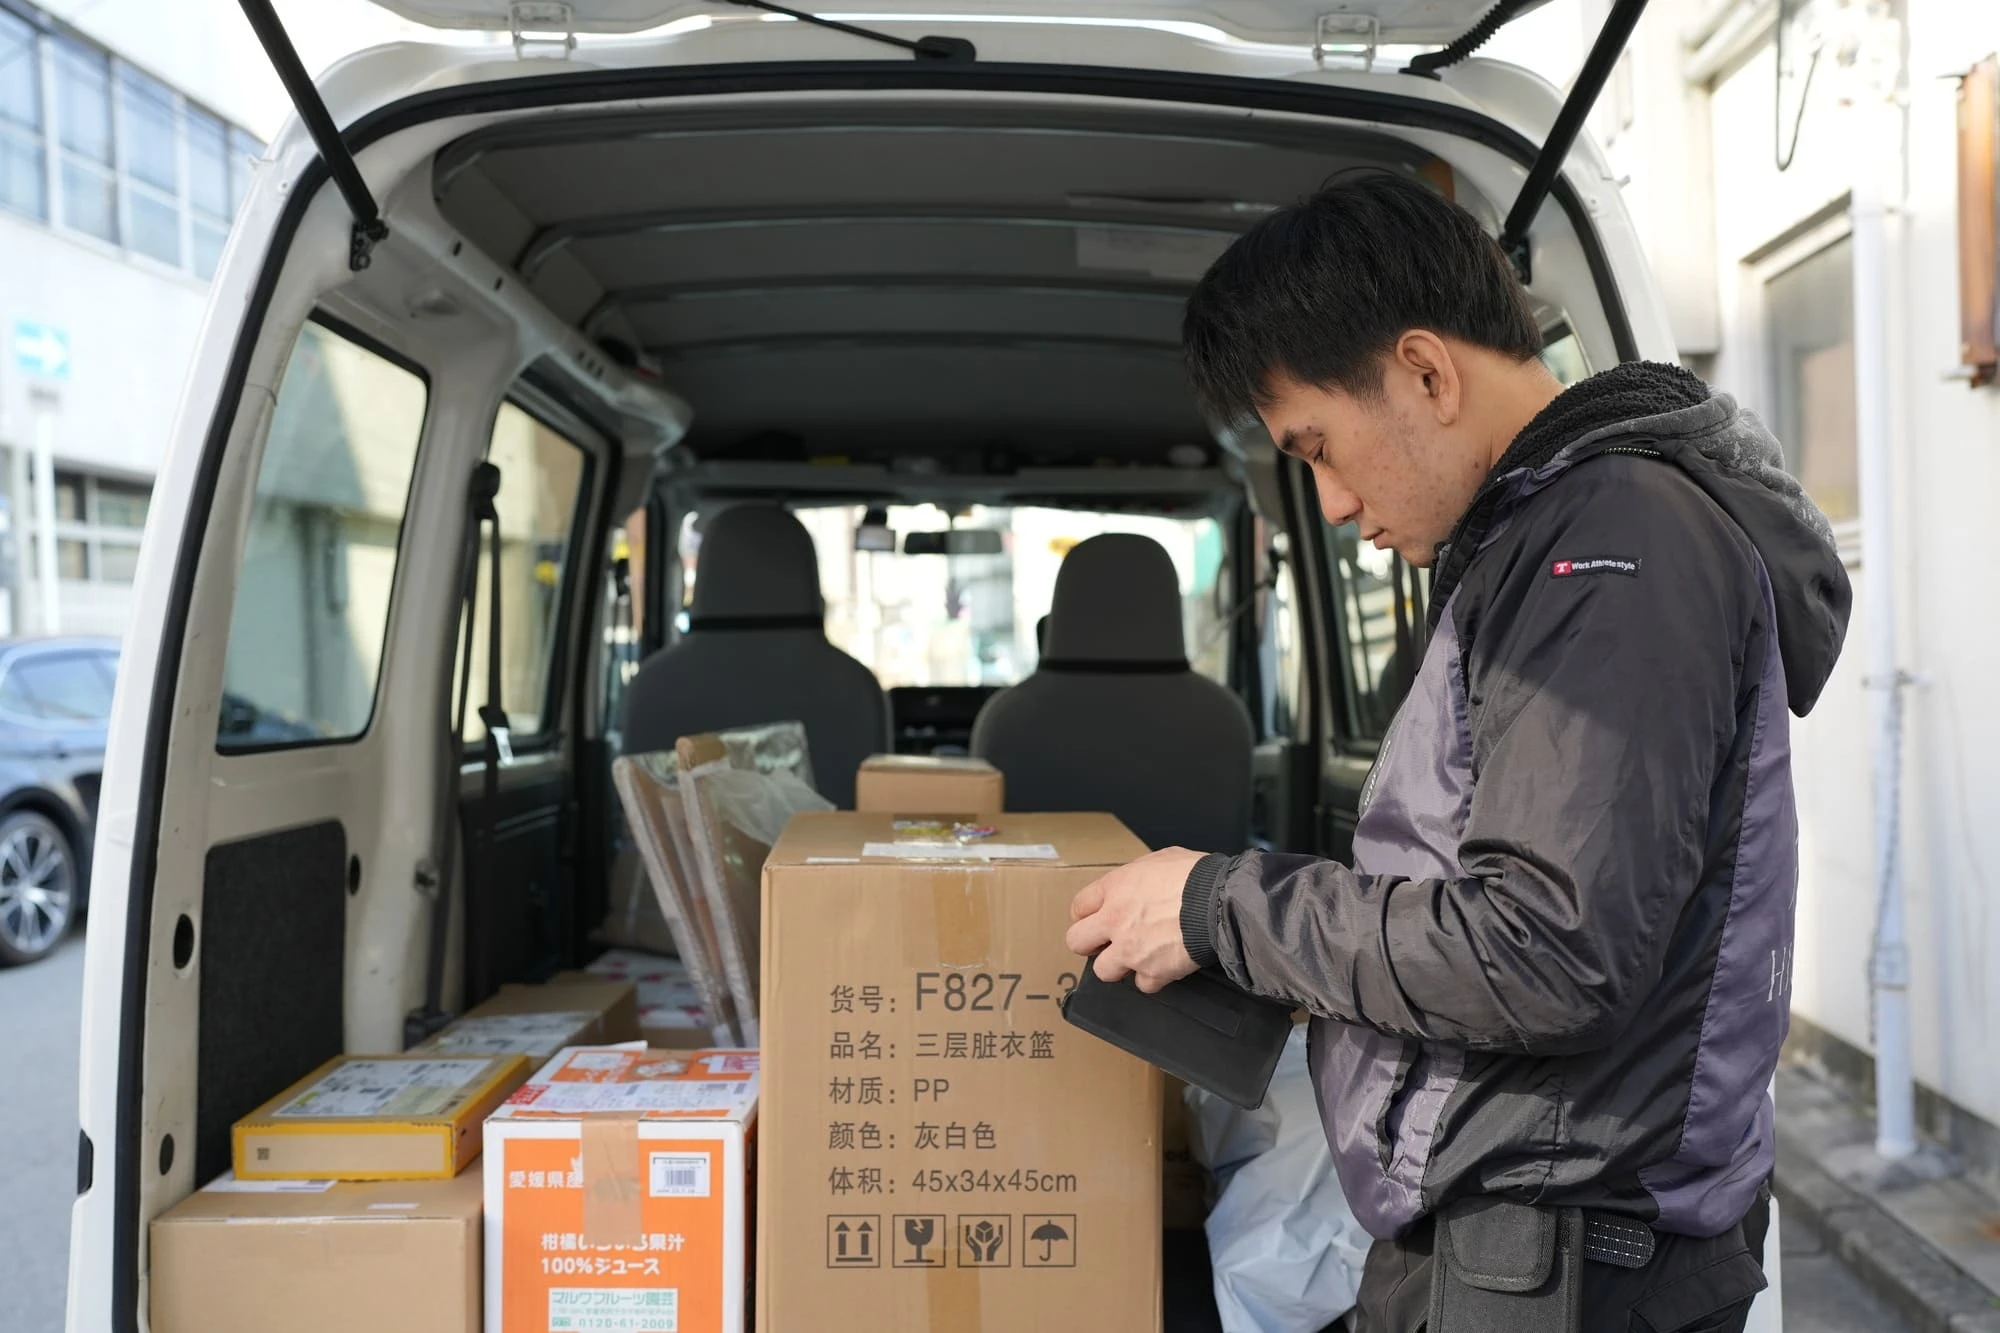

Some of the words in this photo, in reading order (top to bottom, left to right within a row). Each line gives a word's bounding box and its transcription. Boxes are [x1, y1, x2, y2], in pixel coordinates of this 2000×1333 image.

[1572, 561, 1590, 570] Work
[830, 984, 896, 1014] 货号：
[830, 1031, 896, 1060] 品名：
[915, 1031, 1055, 1060] 三层脏衣篮
[829, 1077, 896, 1105] 材质：
[914, 1079, 950, 1102] PP
[829, 1122, 896, 1150] 颜色：
[914, 1122, 997, 1150] 灰白色
[829, 1167, 896, 1196] 体积：
[912, 1170, 1077, 1193] 45x34x45cm
[542, 1258, 660, 1275] 100%ジュース
